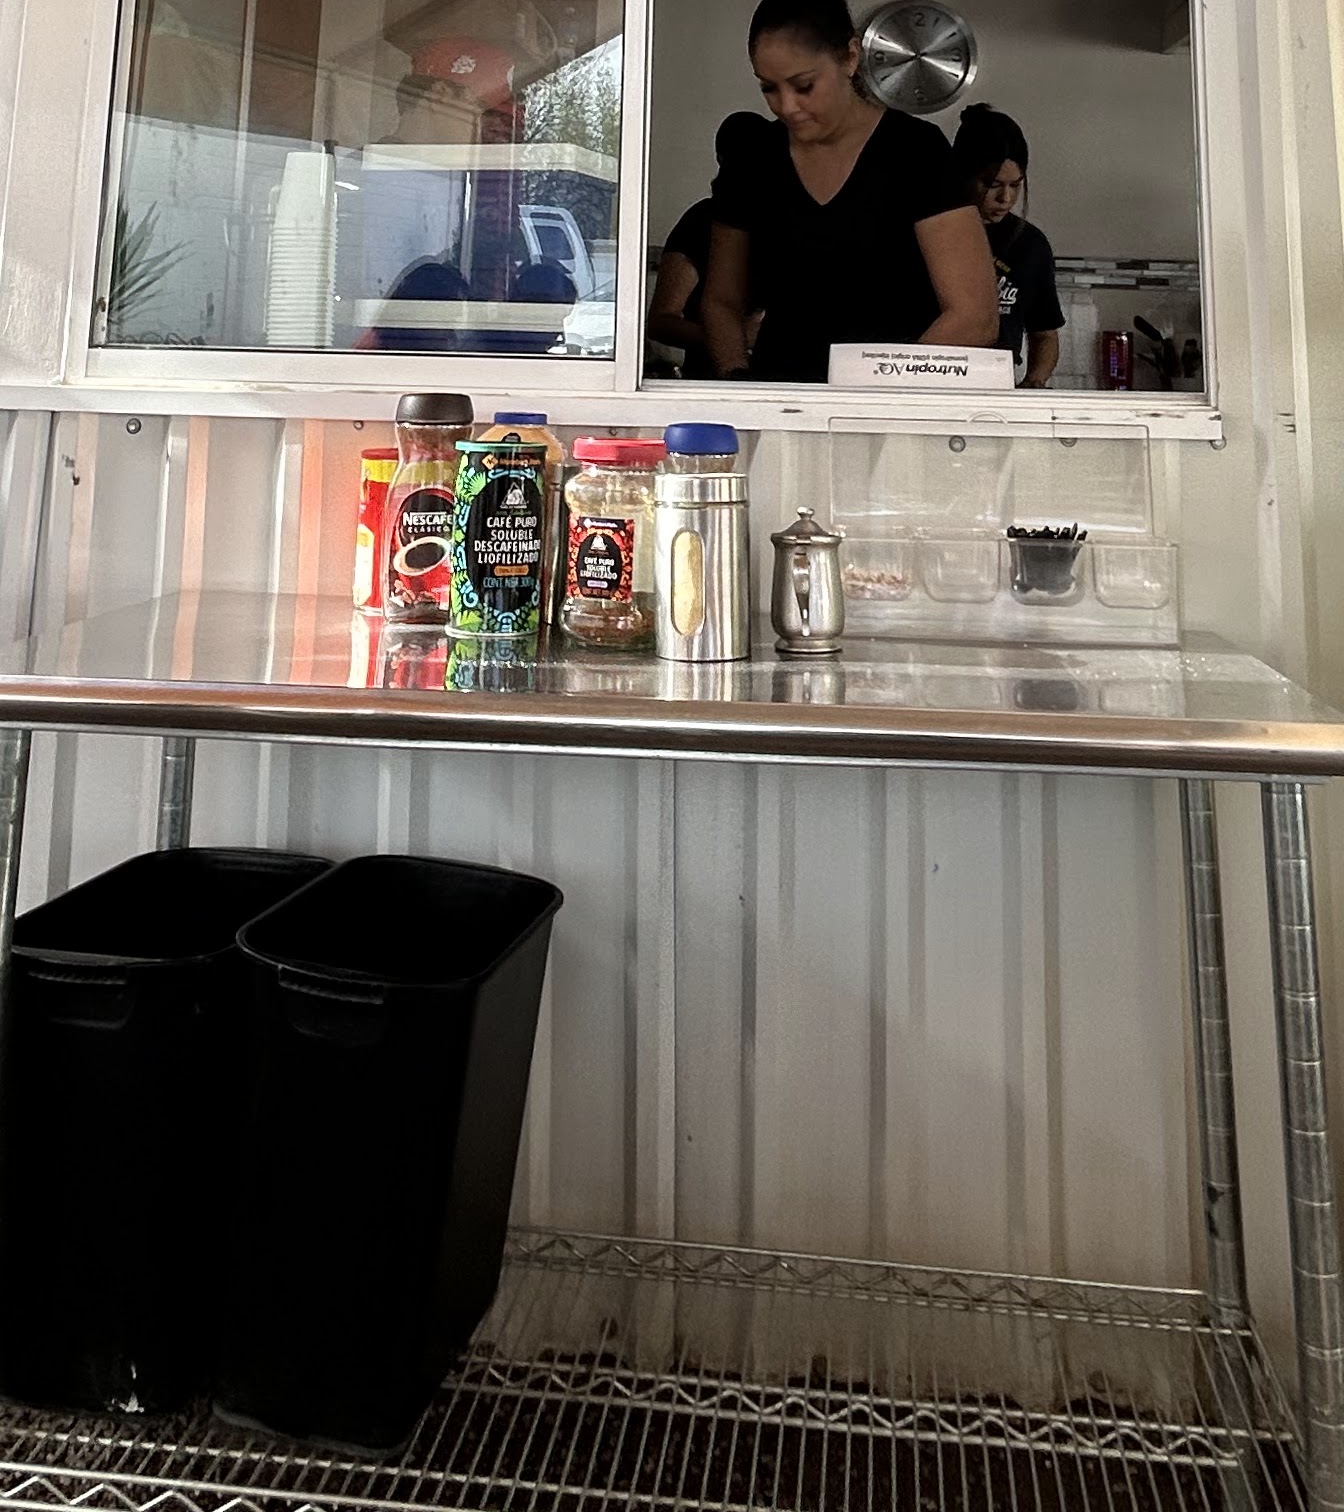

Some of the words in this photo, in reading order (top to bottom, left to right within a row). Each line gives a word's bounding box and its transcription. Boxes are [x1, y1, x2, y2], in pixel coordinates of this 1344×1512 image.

[487, 515, 512, 528] CAFÉ
[491, 529, 533, 541] SOLUBLE
[477, 552, 539, 564] LIOFILIZADO
